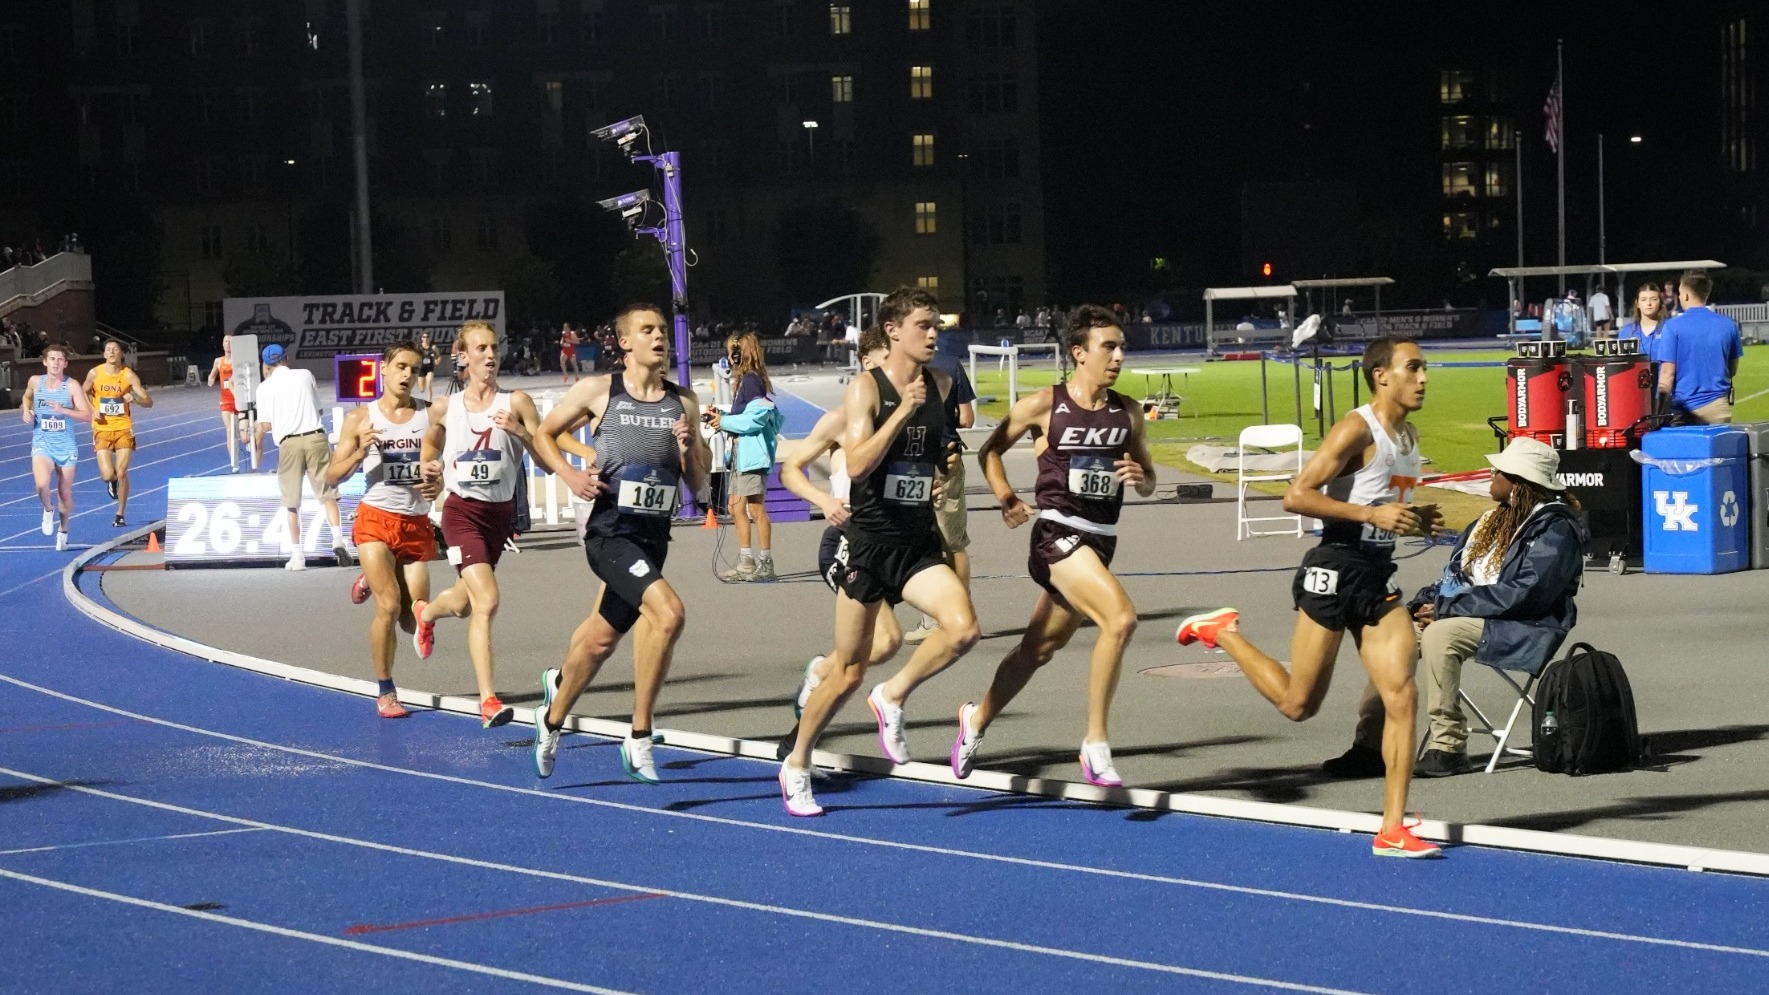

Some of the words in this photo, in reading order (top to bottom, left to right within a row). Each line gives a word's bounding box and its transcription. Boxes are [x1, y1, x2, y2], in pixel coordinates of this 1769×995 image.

[302, 301, 392, 325] TRACK
[398, 301, 415, 323] &
[421, 299, 500, 322] FIELD
[302, 330, 351, 346] EAST
[353, 328, 409, 345] FIRST
[412, 327, 459, 343] ROUN
[1150, 325, 1204, 345] KENTU
[100, 384, 122, 393] IONA
[359, 360, 377, 397] 2
[1517, 368, 1527, 428] BODYARMOR
[1596, 366, 1607, 427] BODYARMOR
[104, 404, 120, 414] 692
[43, 421, 64, 430] 1609
[376, 438, 421, 451] VIRGINI
[904, 426, 927, 457] H
[1059, 426, 1128, 446] EKU
[388, 464, 421, 481] 1714
[471, 464, 489, 480] 49
[1555, 472, 1604, 487] ARMOR
[896, 480, 925, 499] 623
[1080, 473, 1111, 494] 368
[632, 486, 665, 509] 184
[1653, 490, 1699, 532] UK
[173, 501, 328, 554] 26:47
[1311, 570, 1330, 593] 13
